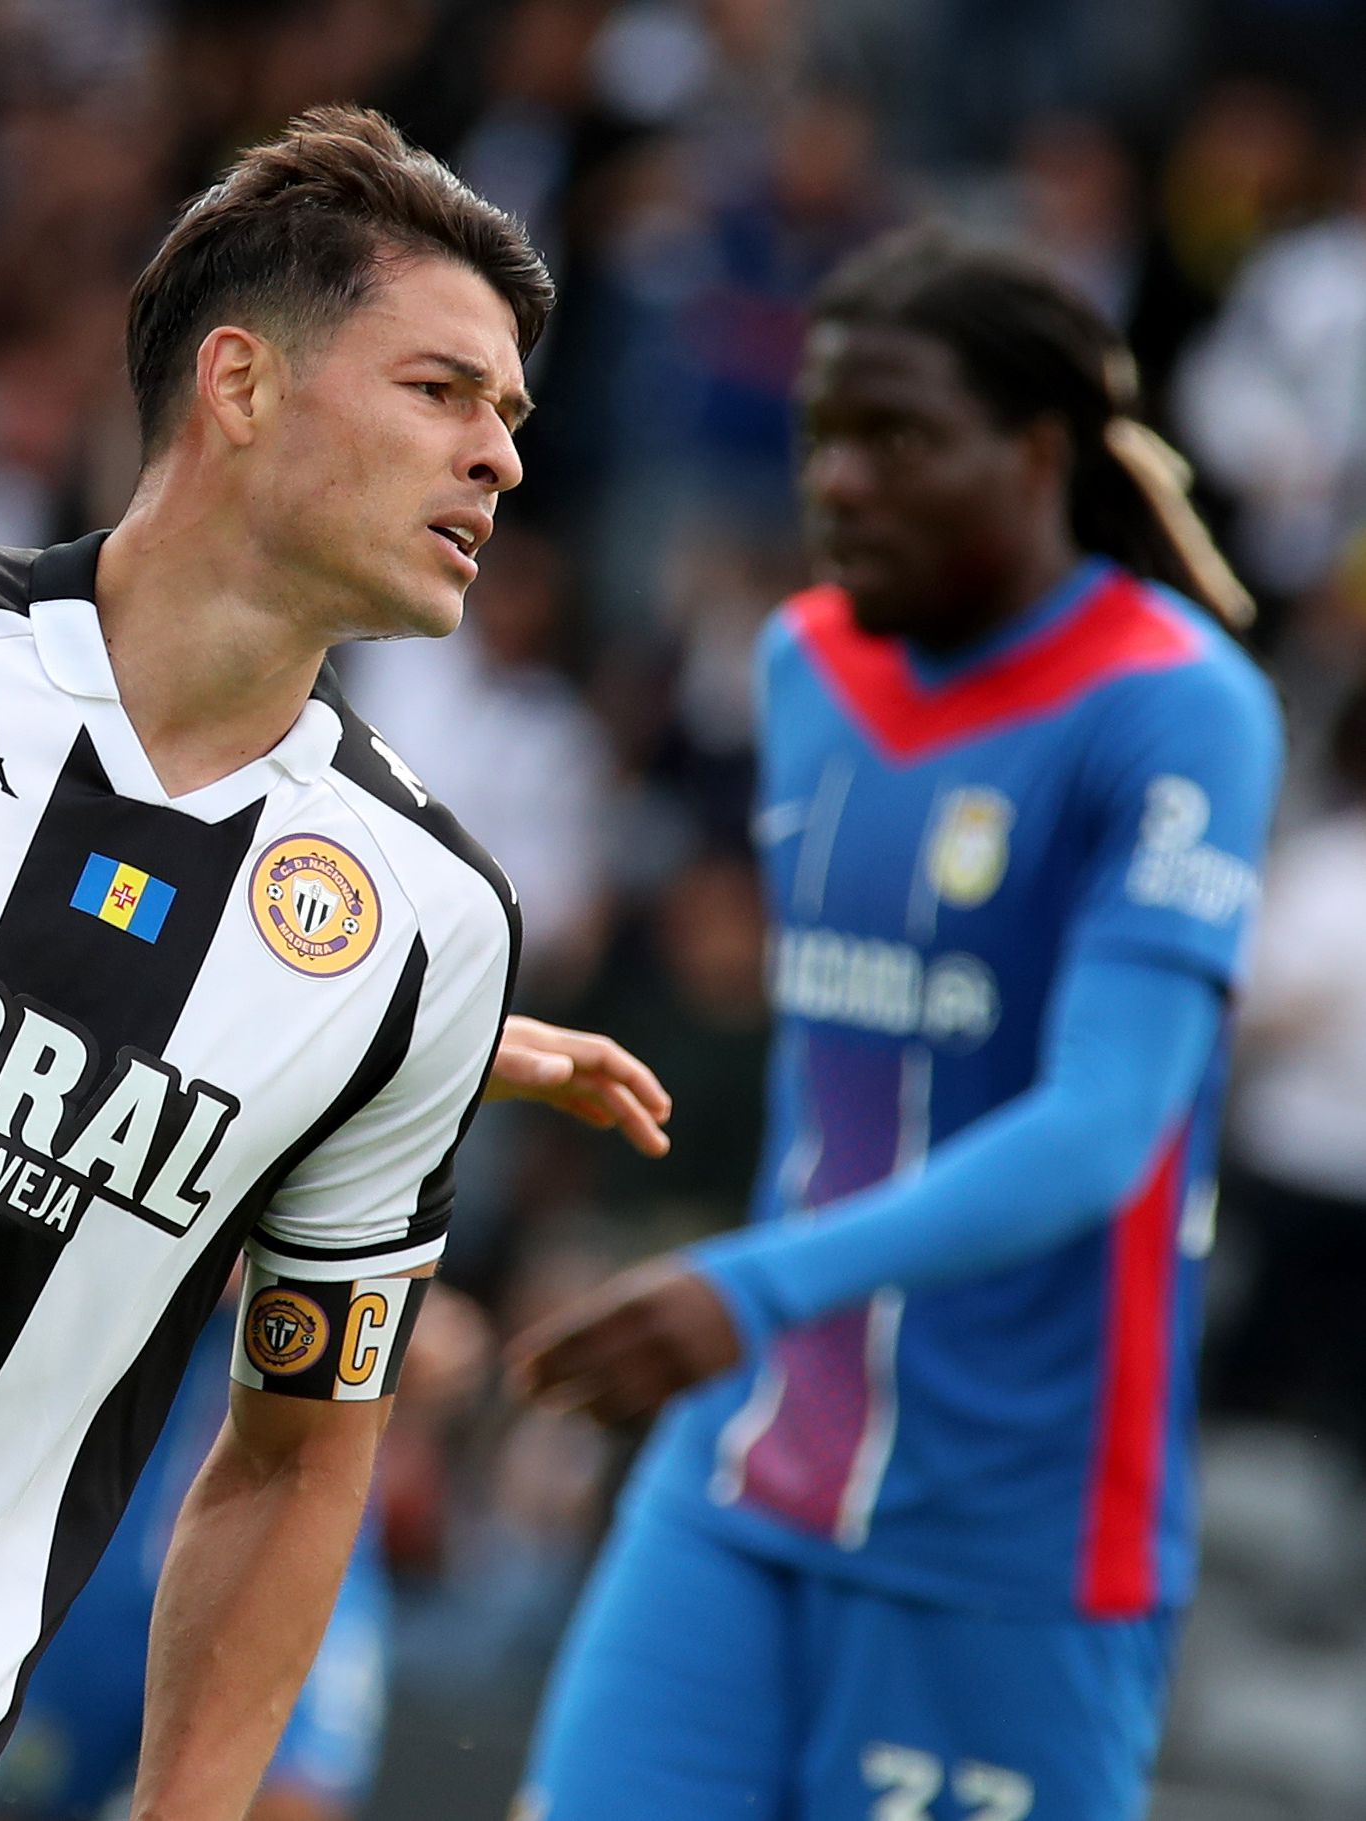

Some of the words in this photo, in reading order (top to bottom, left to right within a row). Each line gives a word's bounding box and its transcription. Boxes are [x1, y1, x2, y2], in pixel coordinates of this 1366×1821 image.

[309, 859, 356, 911] NACIONAL
[278, 923, 333, 955] MADEIRA
[337, 1292, 387, 1385] C
